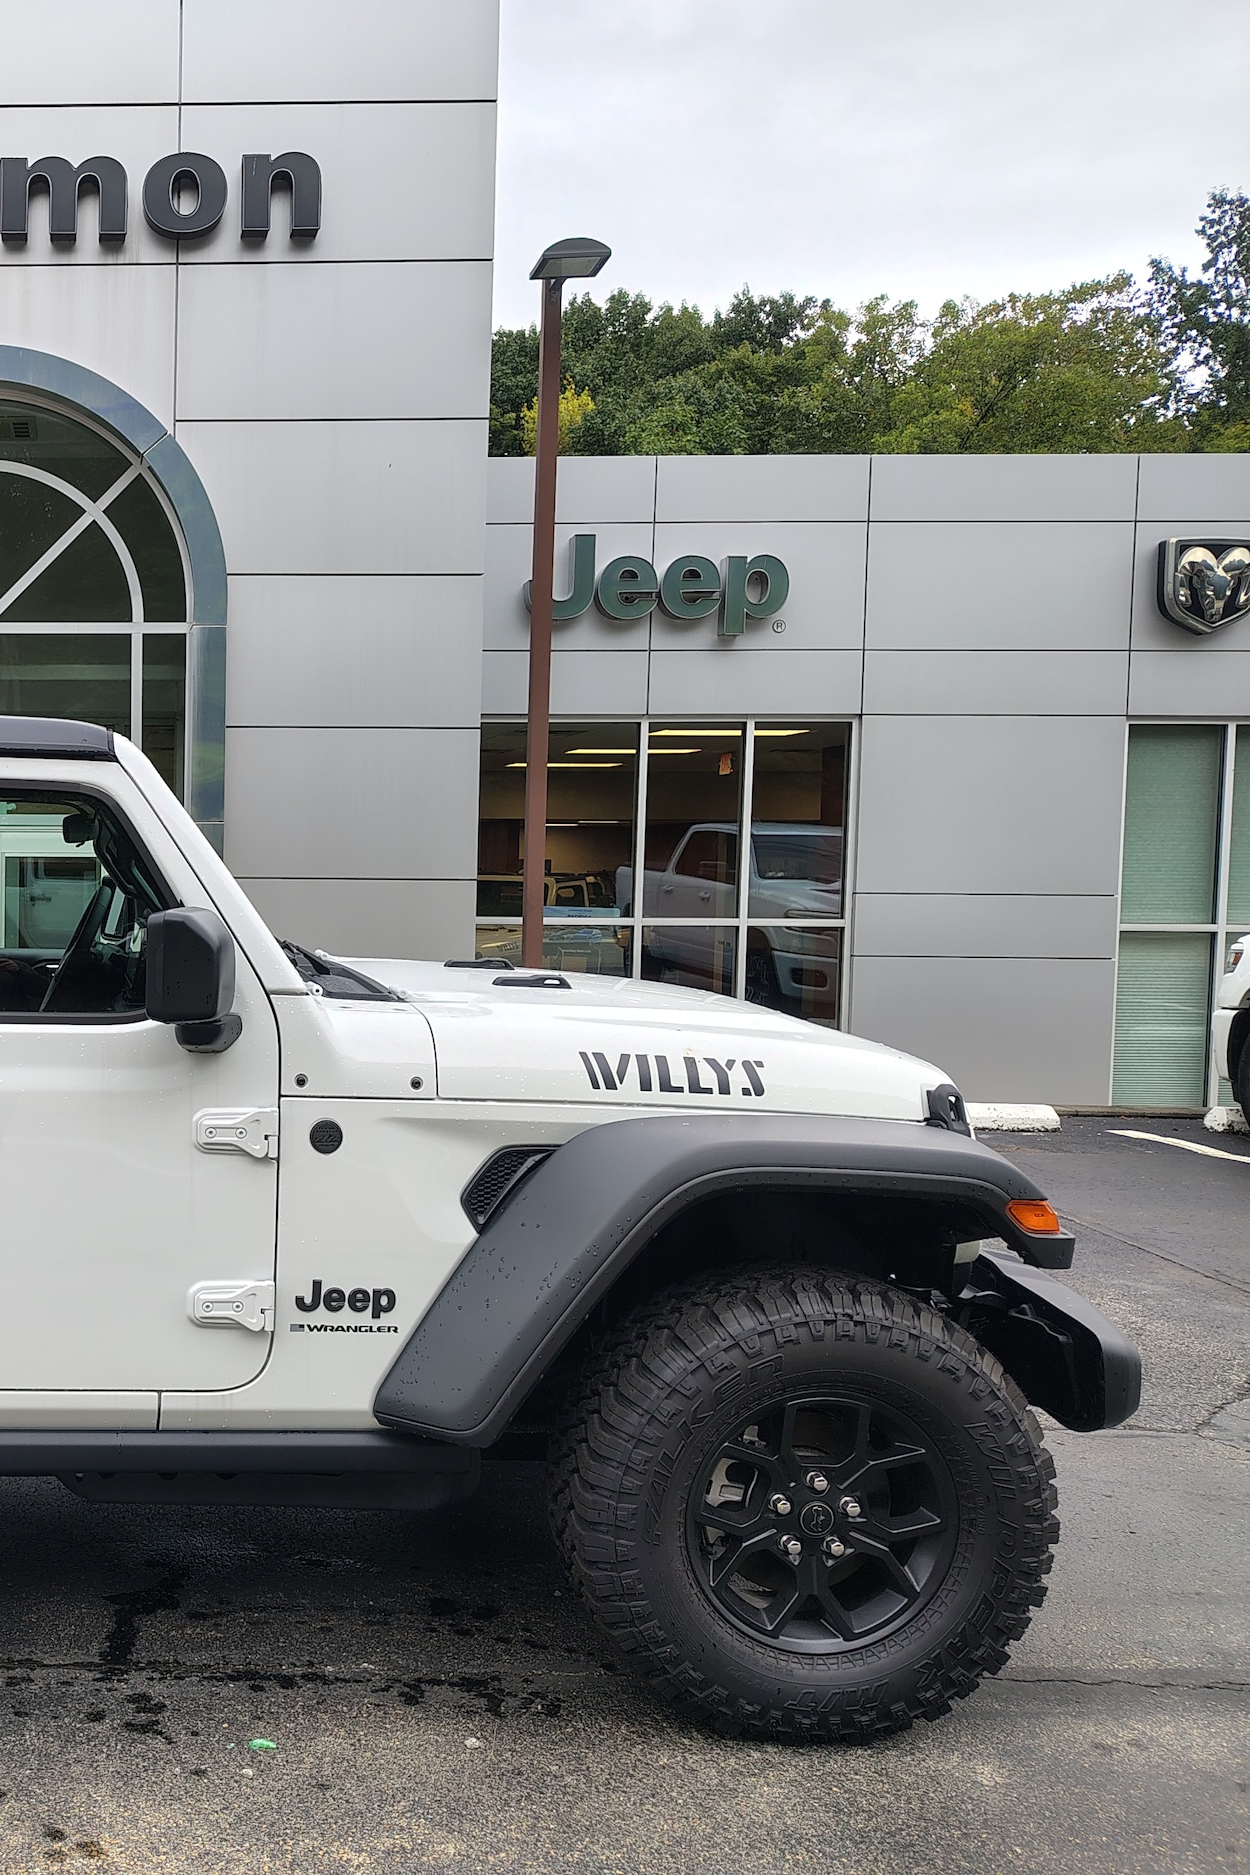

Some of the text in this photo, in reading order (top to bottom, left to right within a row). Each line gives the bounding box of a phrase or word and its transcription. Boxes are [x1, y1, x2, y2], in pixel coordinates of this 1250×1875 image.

[524, 533, 790, 637] Jeep
[578, 1051, 765, 1097] WILLYS
[295, 1279, 397, 1320] Jeep
[306, 1323, 399, 1334] WRANGLER
